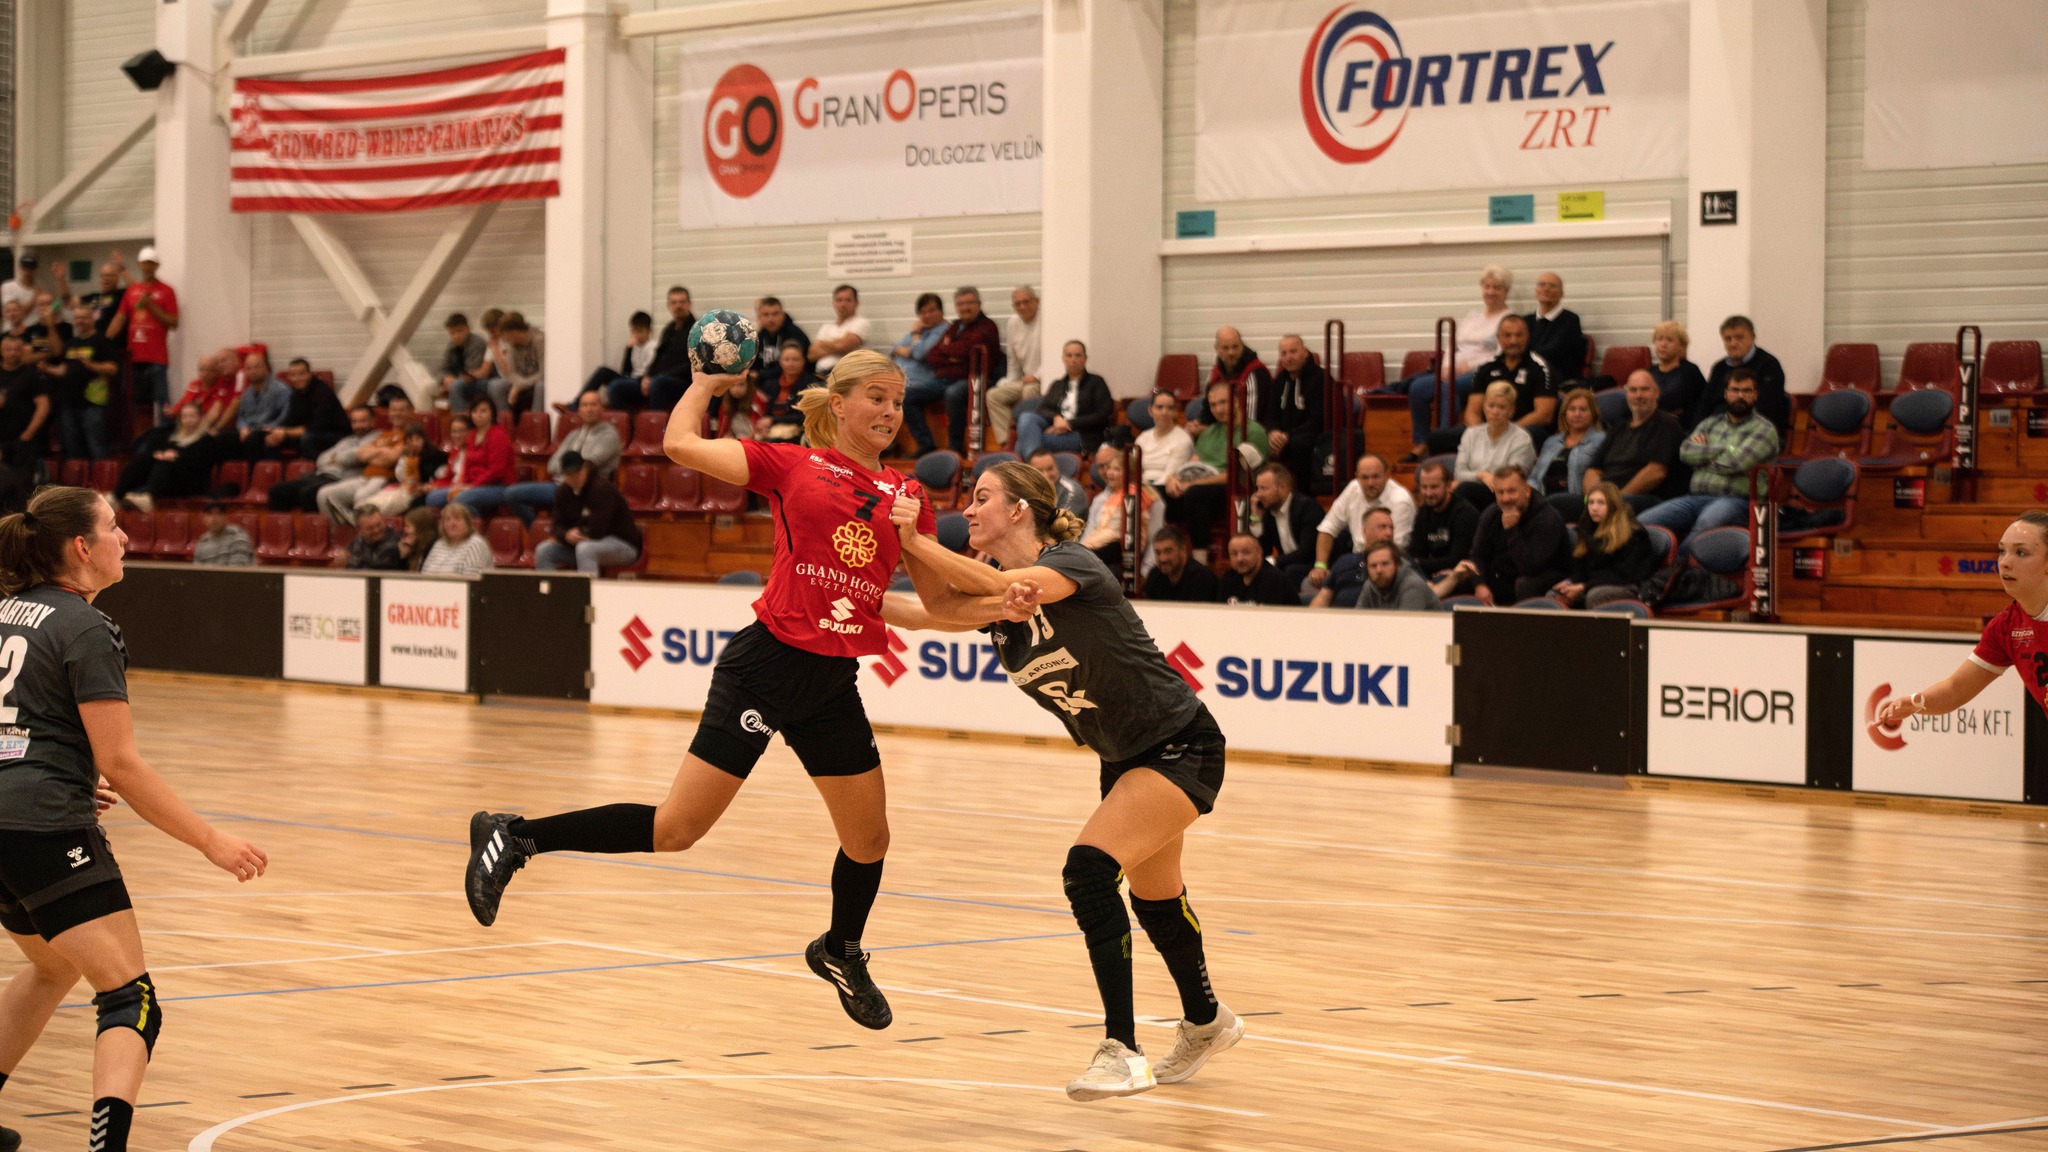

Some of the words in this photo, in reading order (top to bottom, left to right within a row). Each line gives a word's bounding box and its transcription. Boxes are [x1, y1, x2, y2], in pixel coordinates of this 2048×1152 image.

[1336, 41, 1616, 113] FORTREX
[706, 96, 779, 160] GO
[1519, 106, 1610, 150] ZRT
[905, 142, 987, 168] DOLGOZZ
[1958, 365, 1973, 423] VIP
[853, 489, 882, 523] 7
[1123, 498, 1135, 550] VIP
[1753, 506, 1767, 566] VIP
[795, 562, 848, 584] GRAND
[1958, 559, 2000, 574] SUZ
[810, 577, 875, 604] ESZTERGO
[387, 602, 461, 629] GRANCAFÉ
[0, 634, 29, 724] 2
[1027, 657, 1070, 678] ARCONIC
[1215, 655, 1409, 708] SUZUKI
[1956, 707, 1978, 734] 84
[1983, 709, 2014, 737] KFT.
